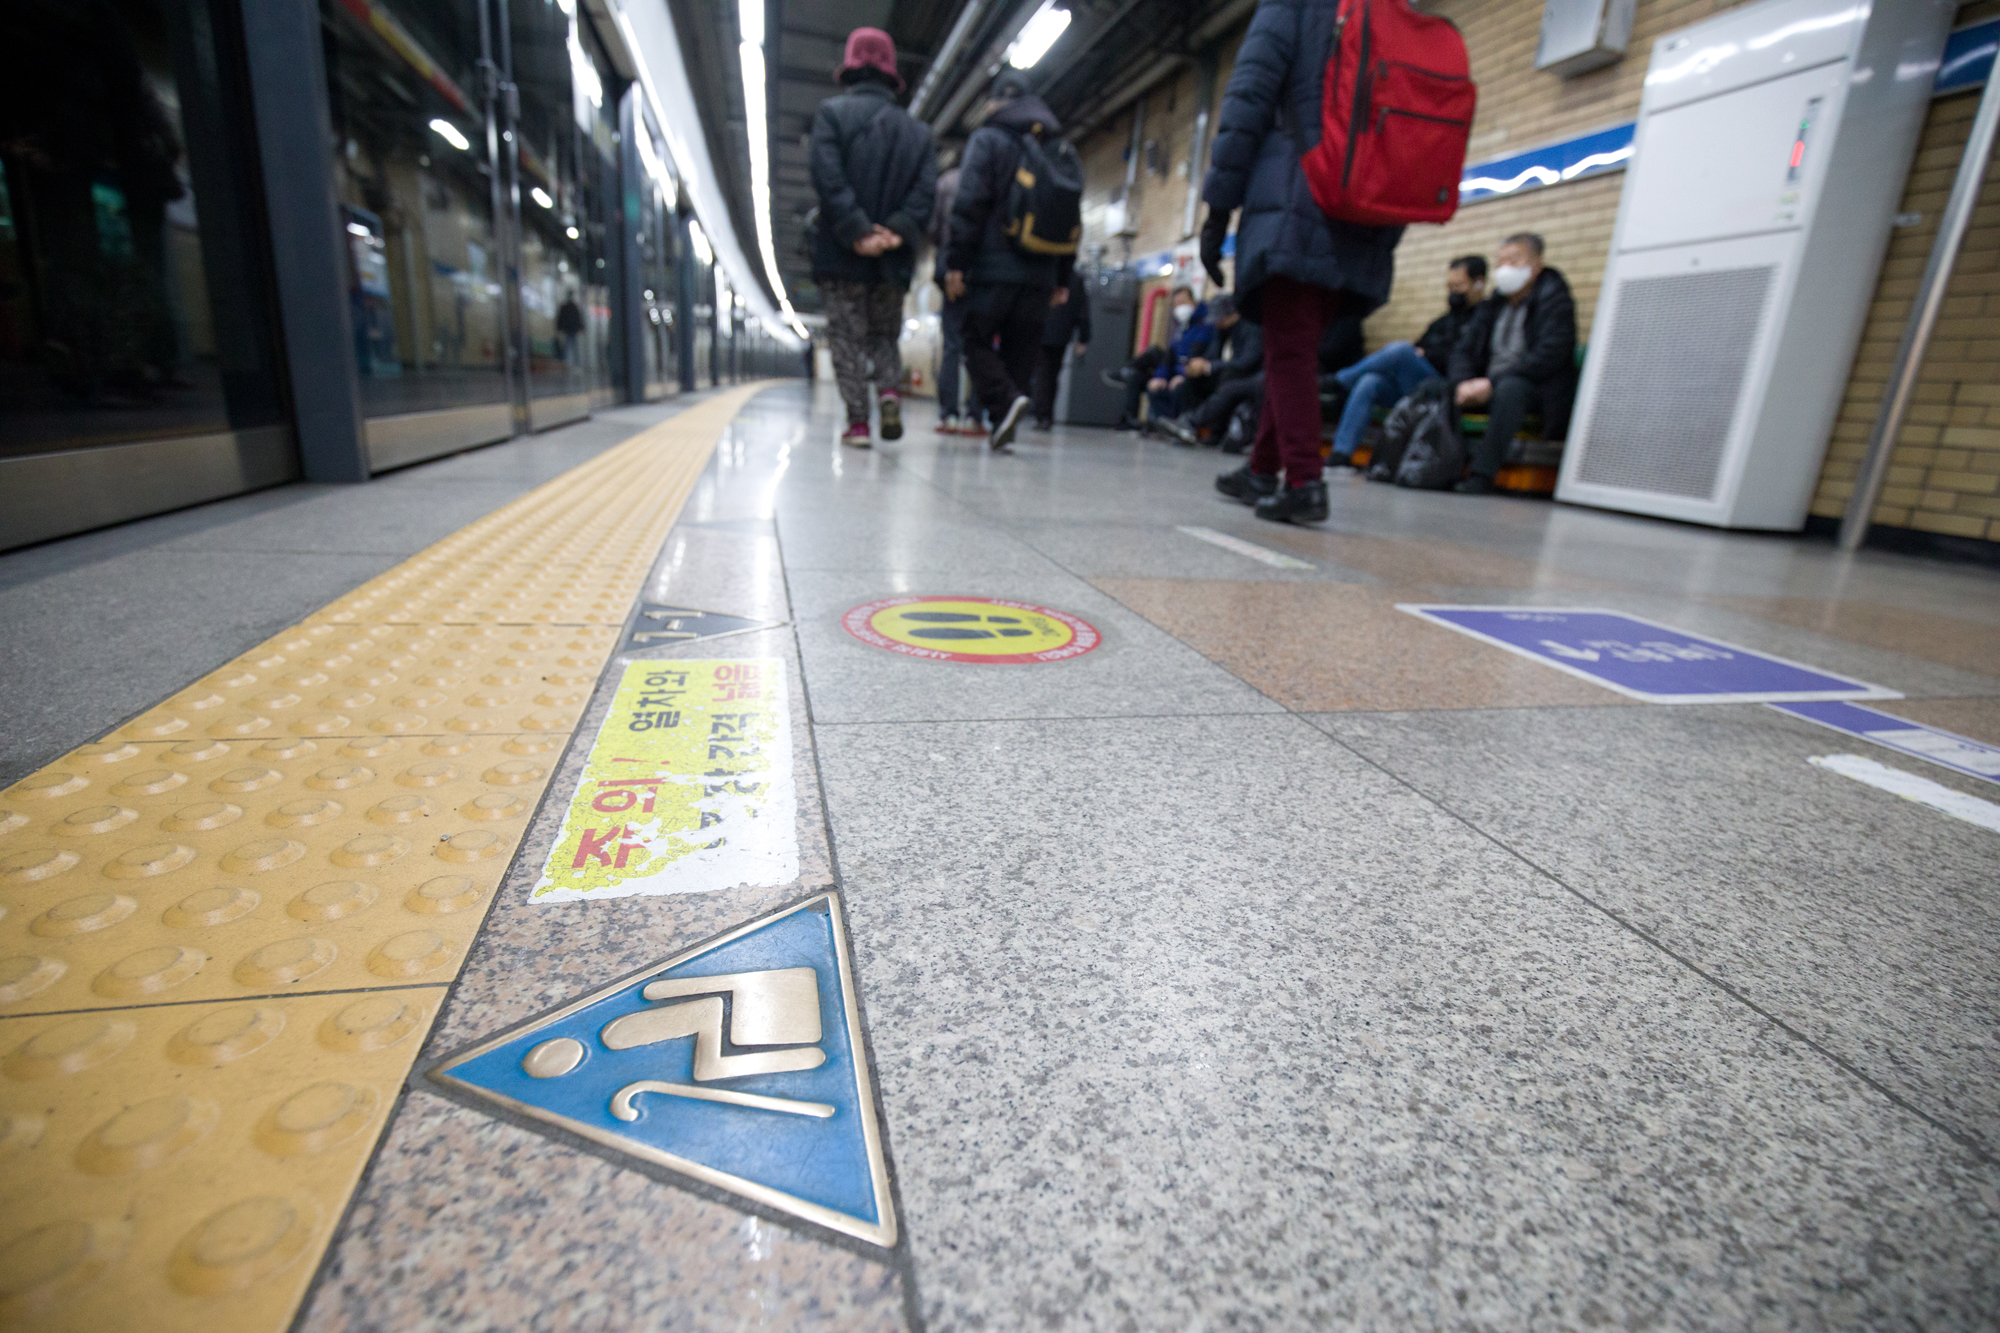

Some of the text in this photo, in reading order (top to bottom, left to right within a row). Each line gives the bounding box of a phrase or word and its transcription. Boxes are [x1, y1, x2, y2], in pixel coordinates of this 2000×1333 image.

[712, 664, 760, 702] 넓음
[572, 669, 690, 869] 주의! 열차와
